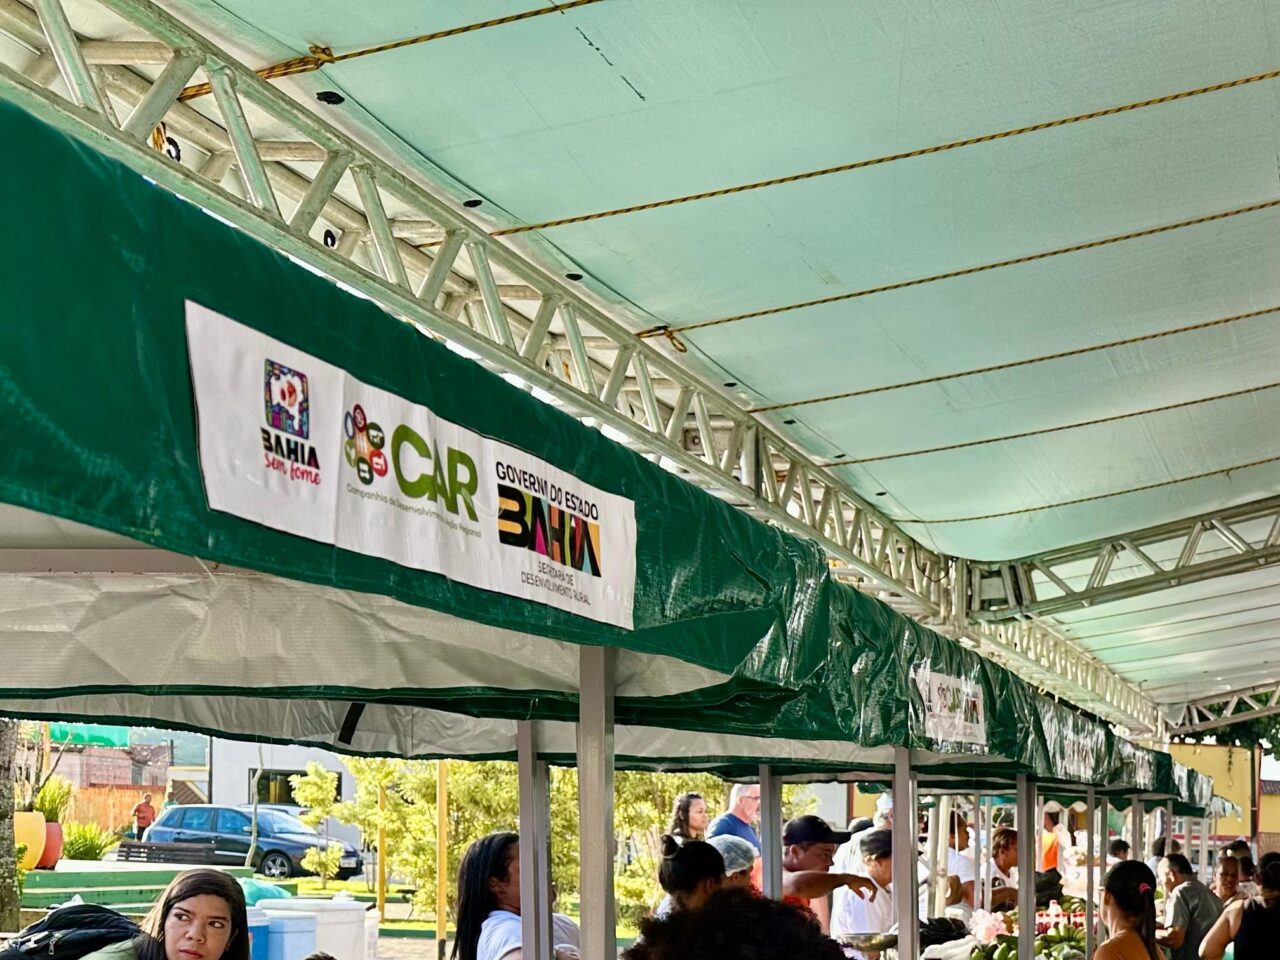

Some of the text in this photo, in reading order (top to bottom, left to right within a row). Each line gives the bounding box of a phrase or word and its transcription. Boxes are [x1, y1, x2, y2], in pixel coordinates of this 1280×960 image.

[261, 427, 320, 470] BAHIA
[264, 452, 321, 485] sem fome
[391, 423, 479, 523] CAR
[346, 482, 388, 505] Companhia
[550, 483, 562, 506] DO
[565, 491, 599, 521] ESTADO
[497, 483, 602, 578] BAHIA
